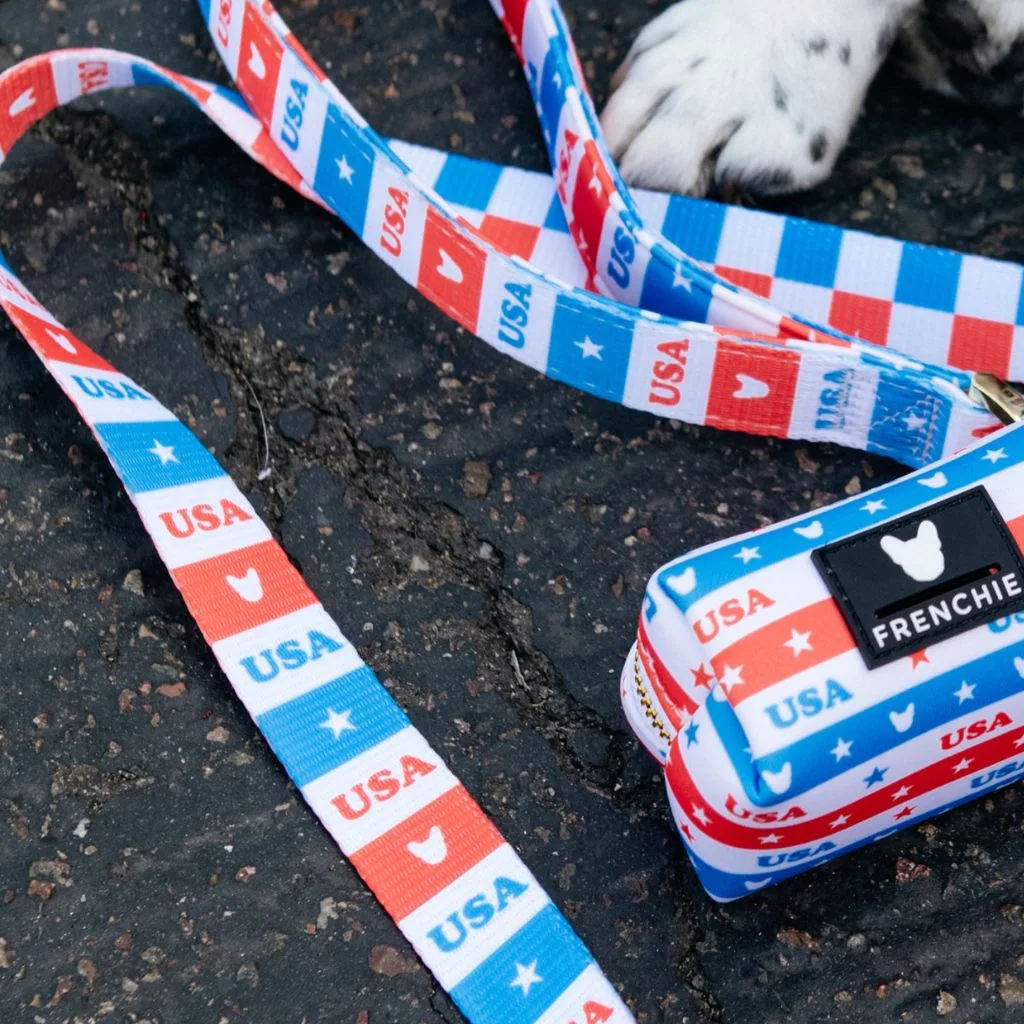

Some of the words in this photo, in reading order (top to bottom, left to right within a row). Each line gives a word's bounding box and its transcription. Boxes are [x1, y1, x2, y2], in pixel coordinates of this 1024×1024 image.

[280, 77, 308, 151] USA
[380, 186, 409, 257] USA
[497, 281, 532, 349] USA
[70, 374, 152, 401] USA
[648, 338, 689, 407] USA
[159, 499, 252, 538] USA
[692, 589, 776, 644] USA
[872, 572, 1022, 648] FRENCHIE
[239, 629, 344, 682] USA
[764, 679, 854, 729] USA
[940, 712, 1013, 750] USA
[330, 755, 437, 820] USA
[724, 793, 808, 824] USA
[757, 841, 837, 867] USA
[426, 875, 529, 953] USA
